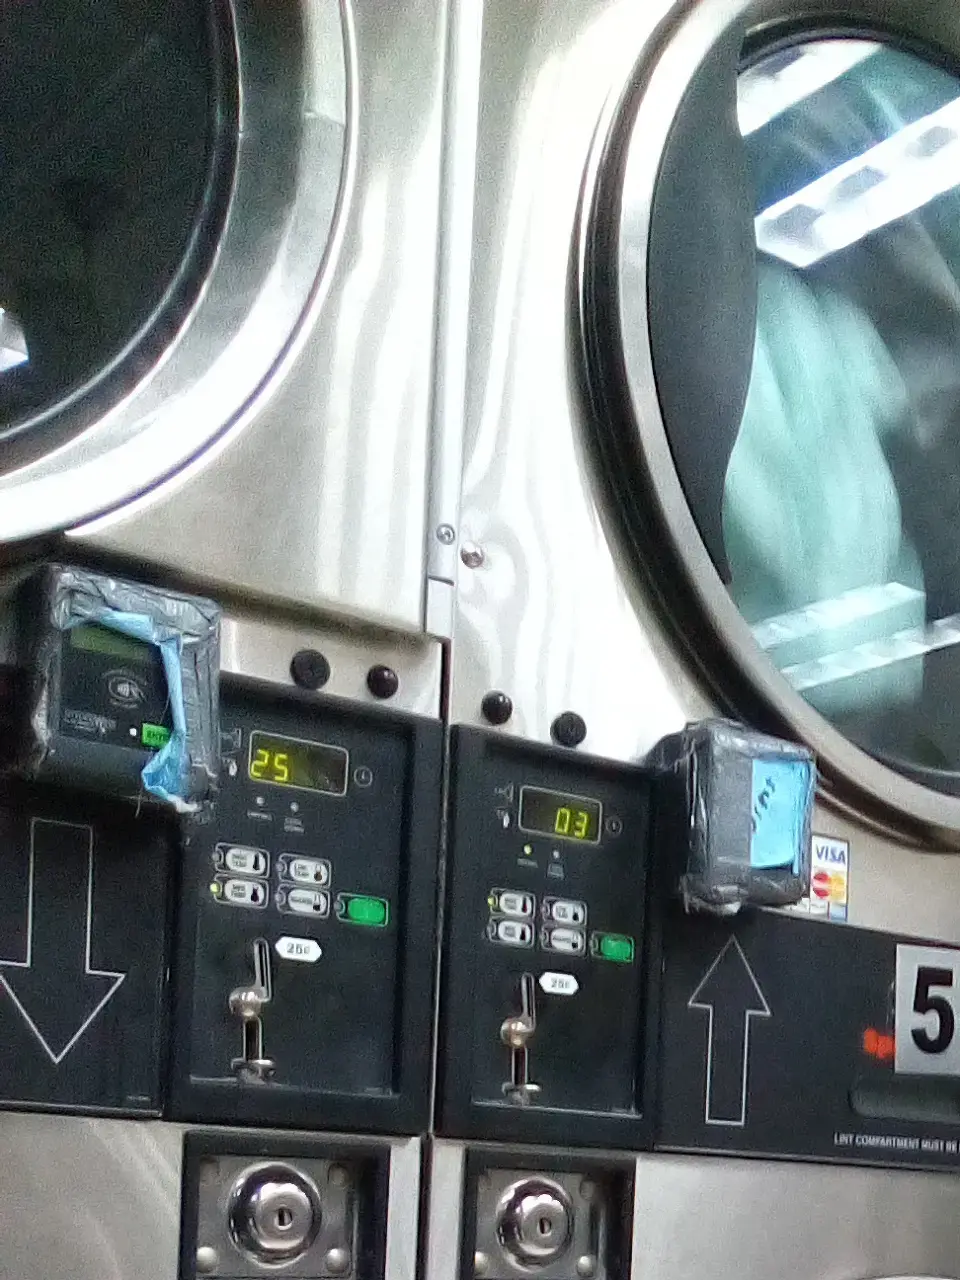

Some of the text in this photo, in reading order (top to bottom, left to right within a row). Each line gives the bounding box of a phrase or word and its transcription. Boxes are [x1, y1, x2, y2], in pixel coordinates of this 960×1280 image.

[251, 749, 288, 781] 25
[555, 808, 590, 839] 03
[816, 844, 846, 865] VISA
[911, 965, 955, 1054] 5
